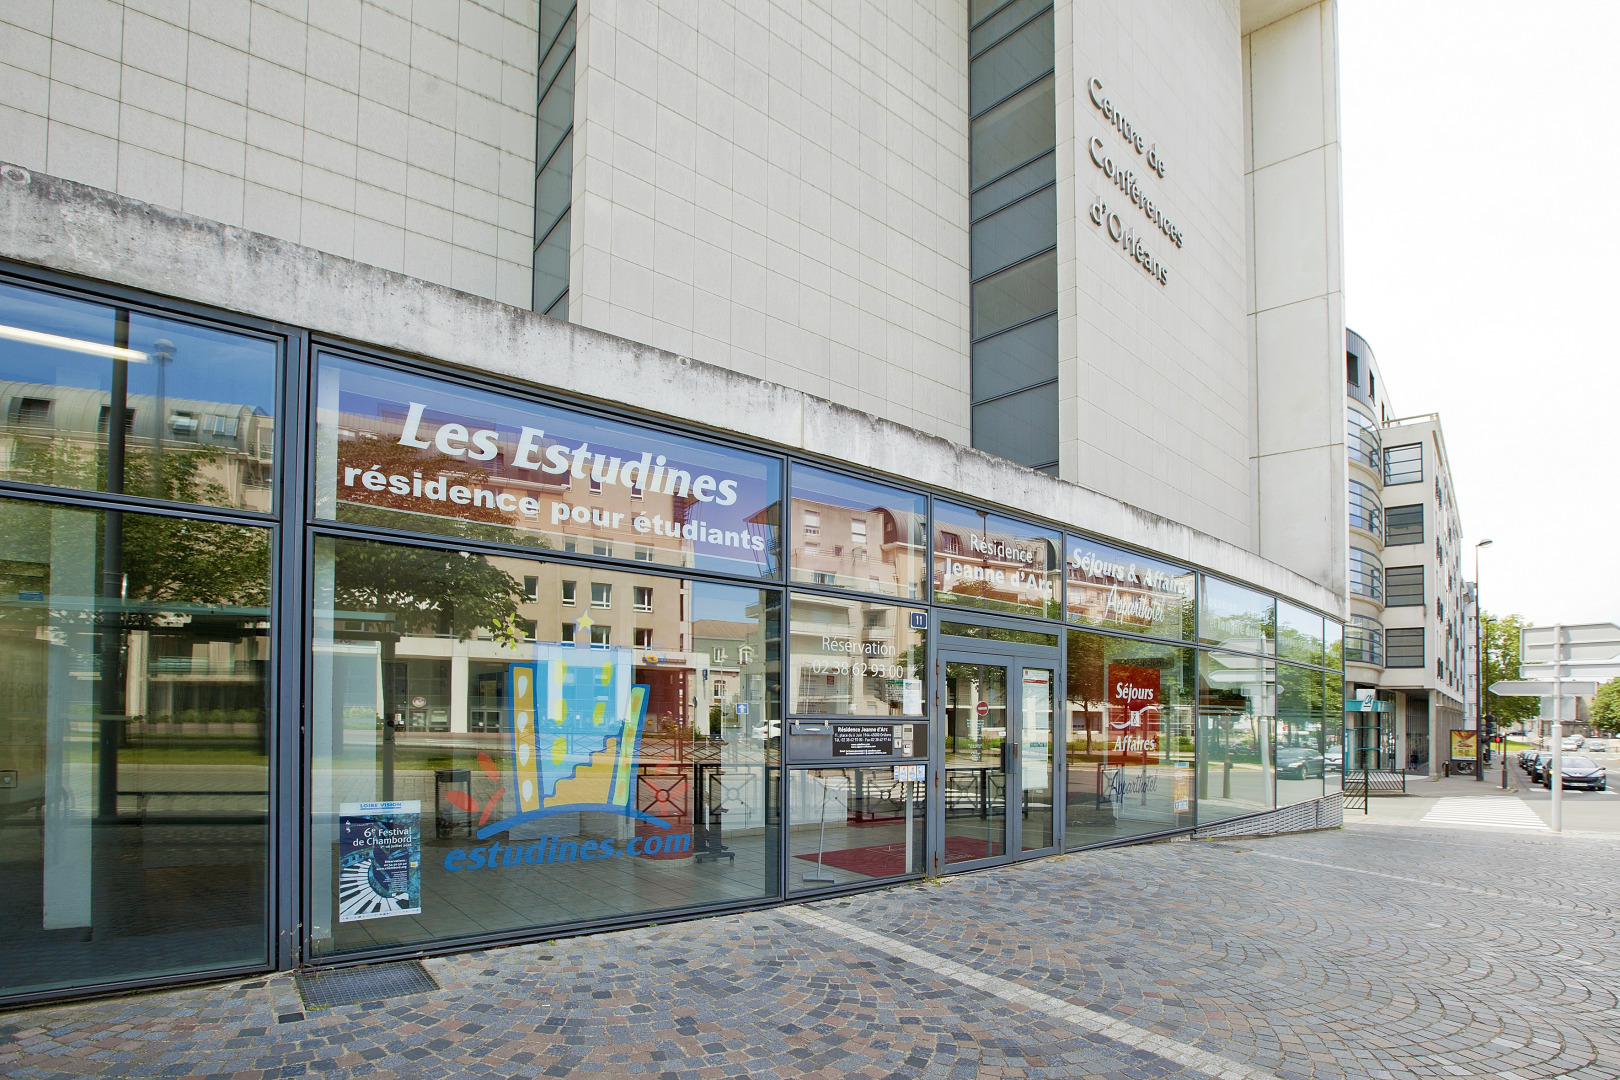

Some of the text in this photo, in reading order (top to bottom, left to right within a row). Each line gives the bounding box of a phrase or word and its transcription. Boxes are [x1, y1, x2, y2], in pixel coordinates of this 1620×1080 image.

[1088, 77, 1165, 178] Centre de
[1088, 135, 1184, 248] Conférences
[1090, 196, 1168, 286] d'Orléans
[396, 401, 739, 506] Les Estudines
[344, 464, 766, 552] résidence pour étudiants
[970, 534, 1032, 564] Résidence
[946, 558, 1053, 594] Jeanne d'Arc
[1072, 548, 1190, 596] Séjours & Affaires
[915, 615, 922, 626] 11
[822, 636, 896, 656] Réservation
[812, 660, 904, 678] 02 38 62 93 00
[1116, 682, 1154, 703] Séjours
[1112, 736, 1155, 752] Affaires
[352, 835, 412, 846] de Chambord
[378, 827, 412, 836] Festival
[444, 832, 691, 872] estudines.com
